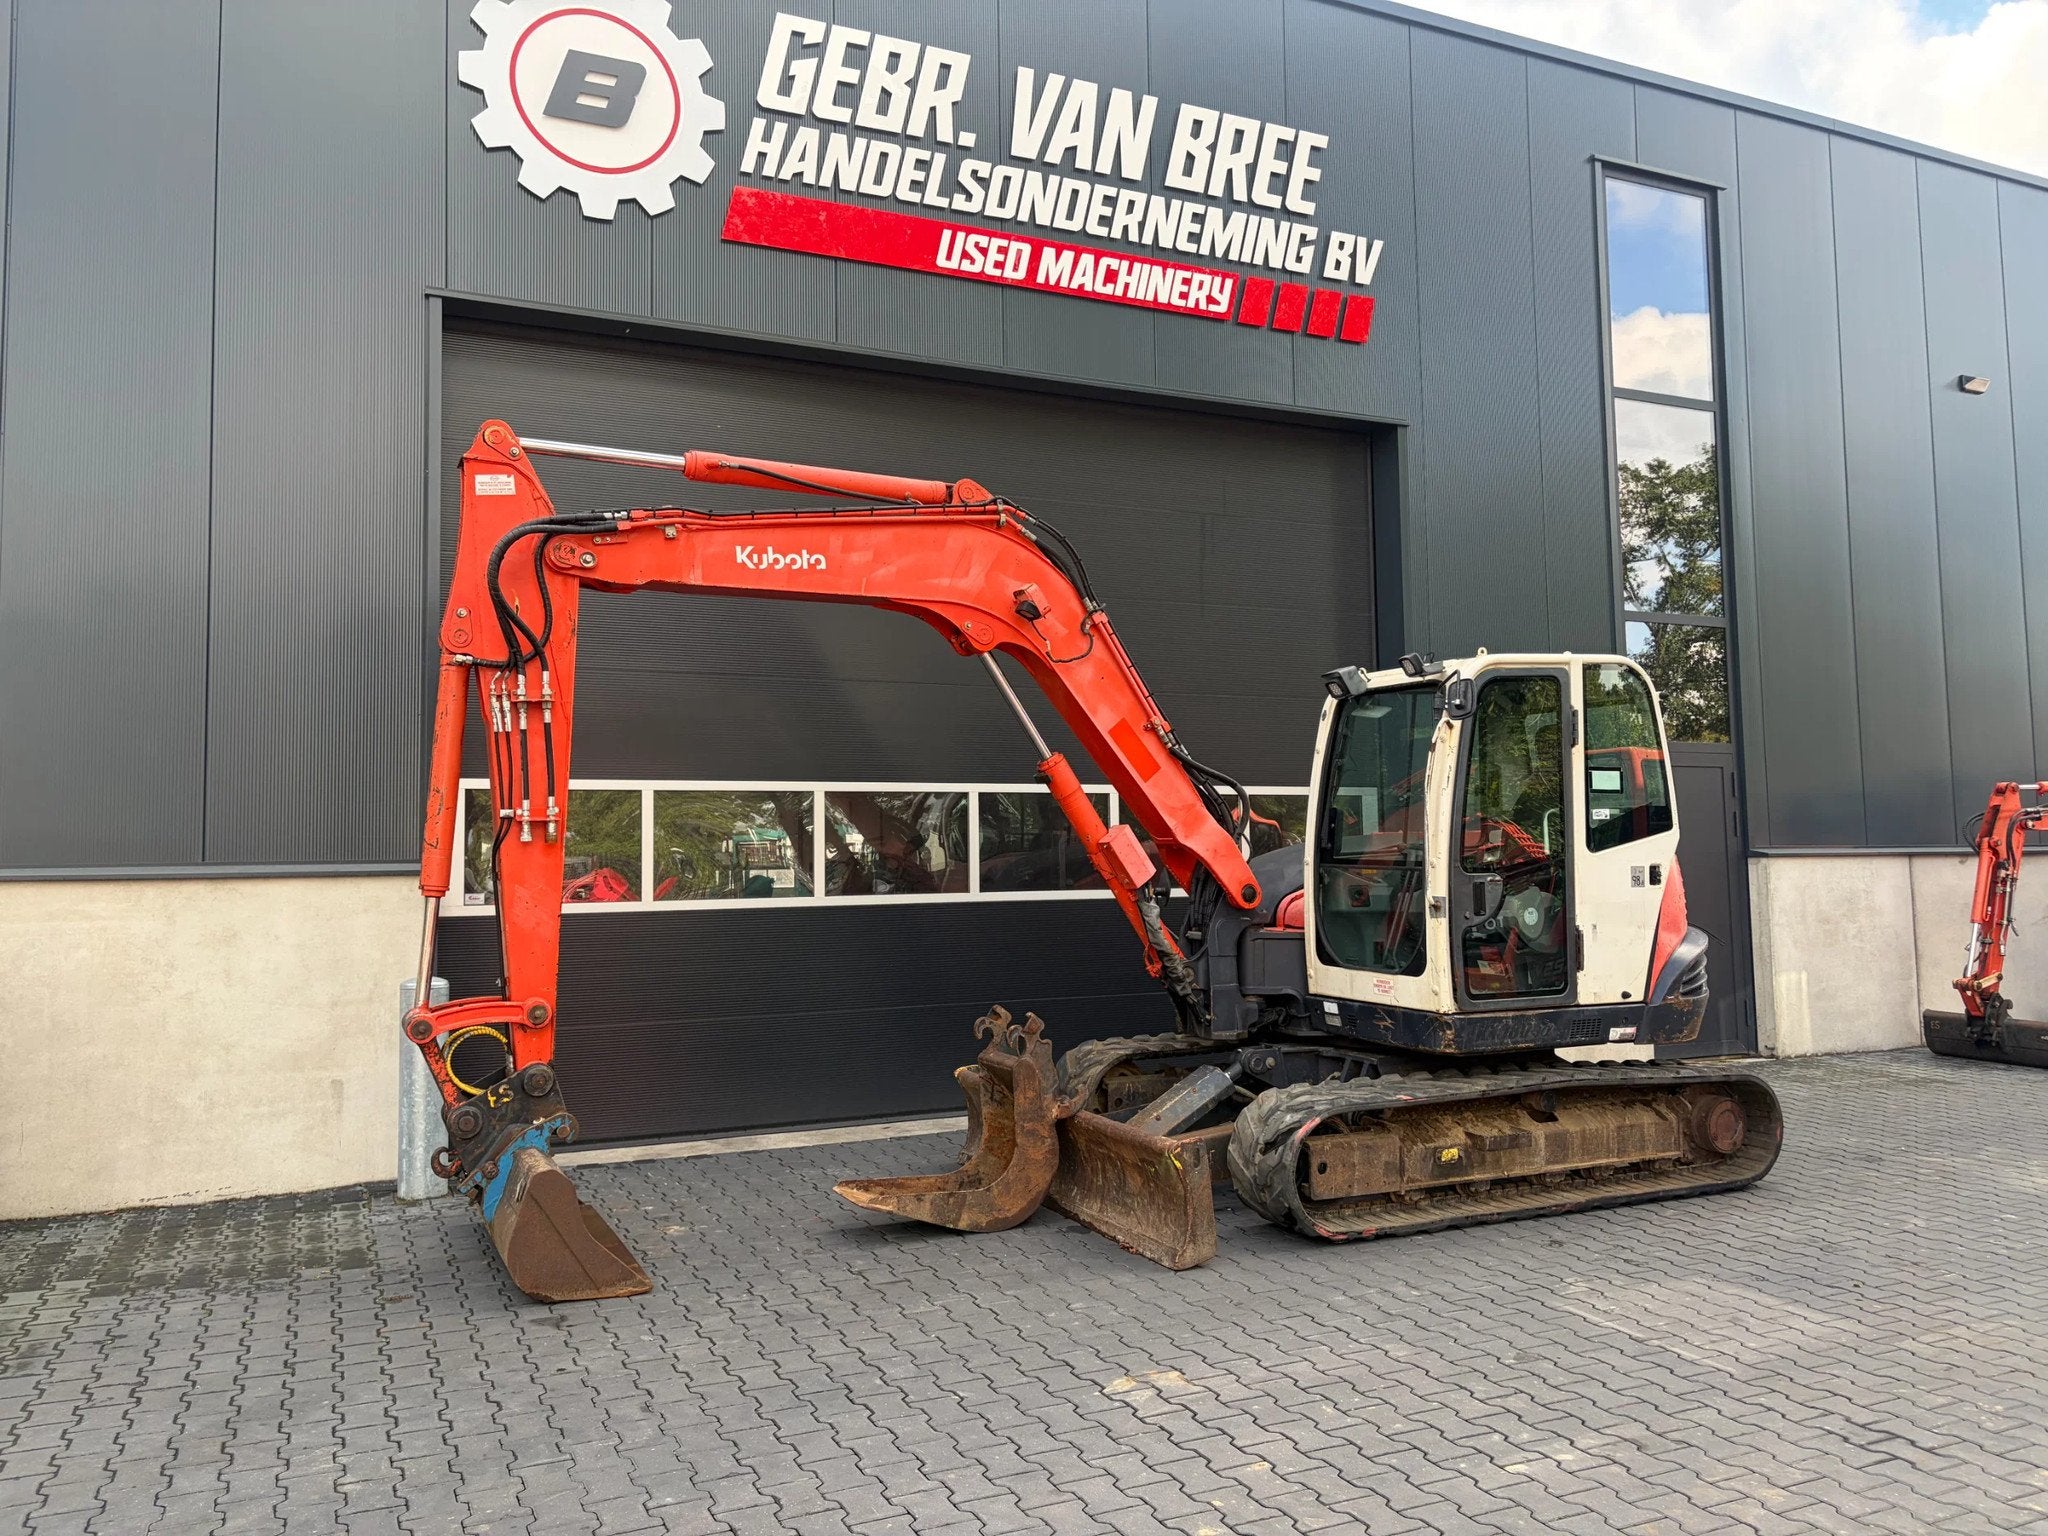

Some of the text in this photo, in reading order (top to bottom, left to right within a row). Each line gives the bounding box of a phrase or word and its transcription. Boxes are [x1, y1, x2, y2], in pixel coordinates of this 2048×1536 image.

[542, 49, 647, 129] B
[756, 11, 1330, 215] GEBR. VAN BREE
[740, 116, 1385, 286] HANDELSONDERNEMING BV
[936, 229, 1243, 313] USED MACHINERY
[735, 545, 827, 570] Kubota
